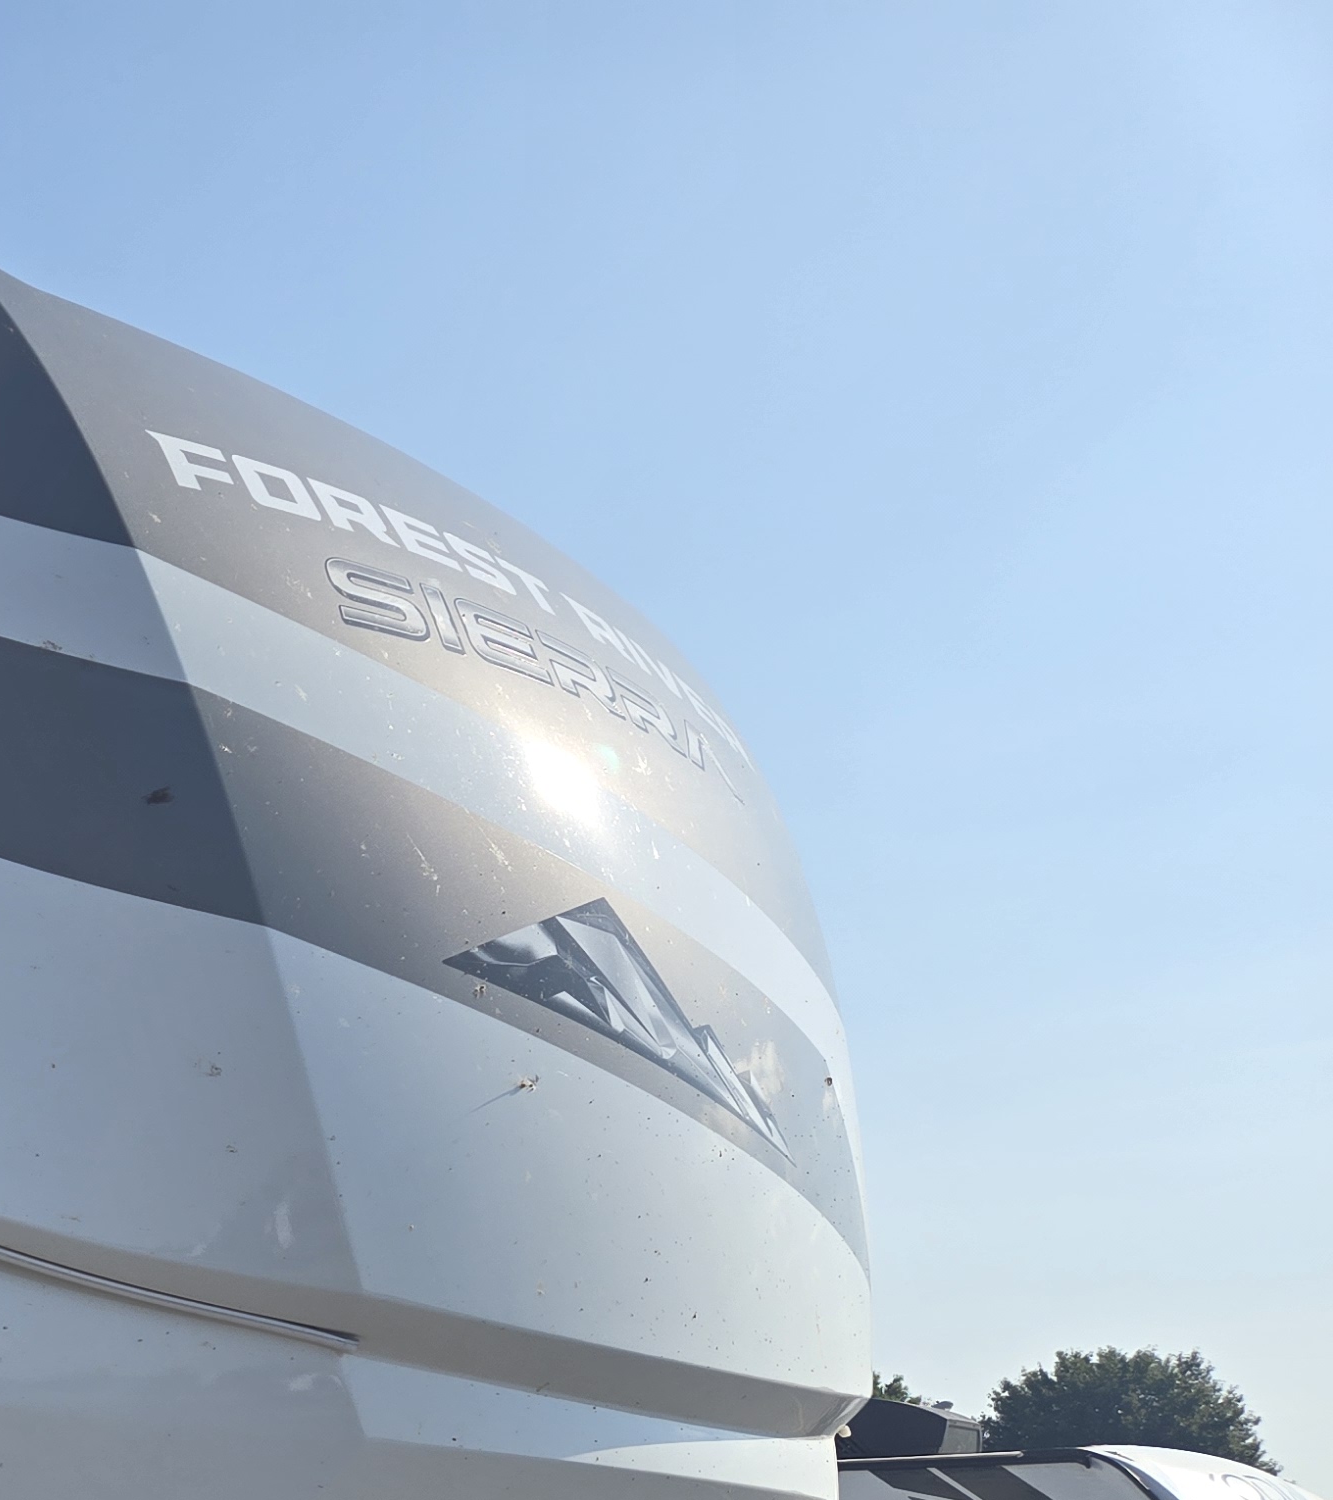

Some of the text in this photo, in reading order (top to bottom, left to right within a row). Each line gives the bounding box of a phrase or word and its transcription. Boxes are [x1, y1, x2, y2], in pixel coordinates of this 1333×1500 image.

[145, 429, 758, 775] FOREST RIVER
[325, 556, 745, 806] SIERRA
